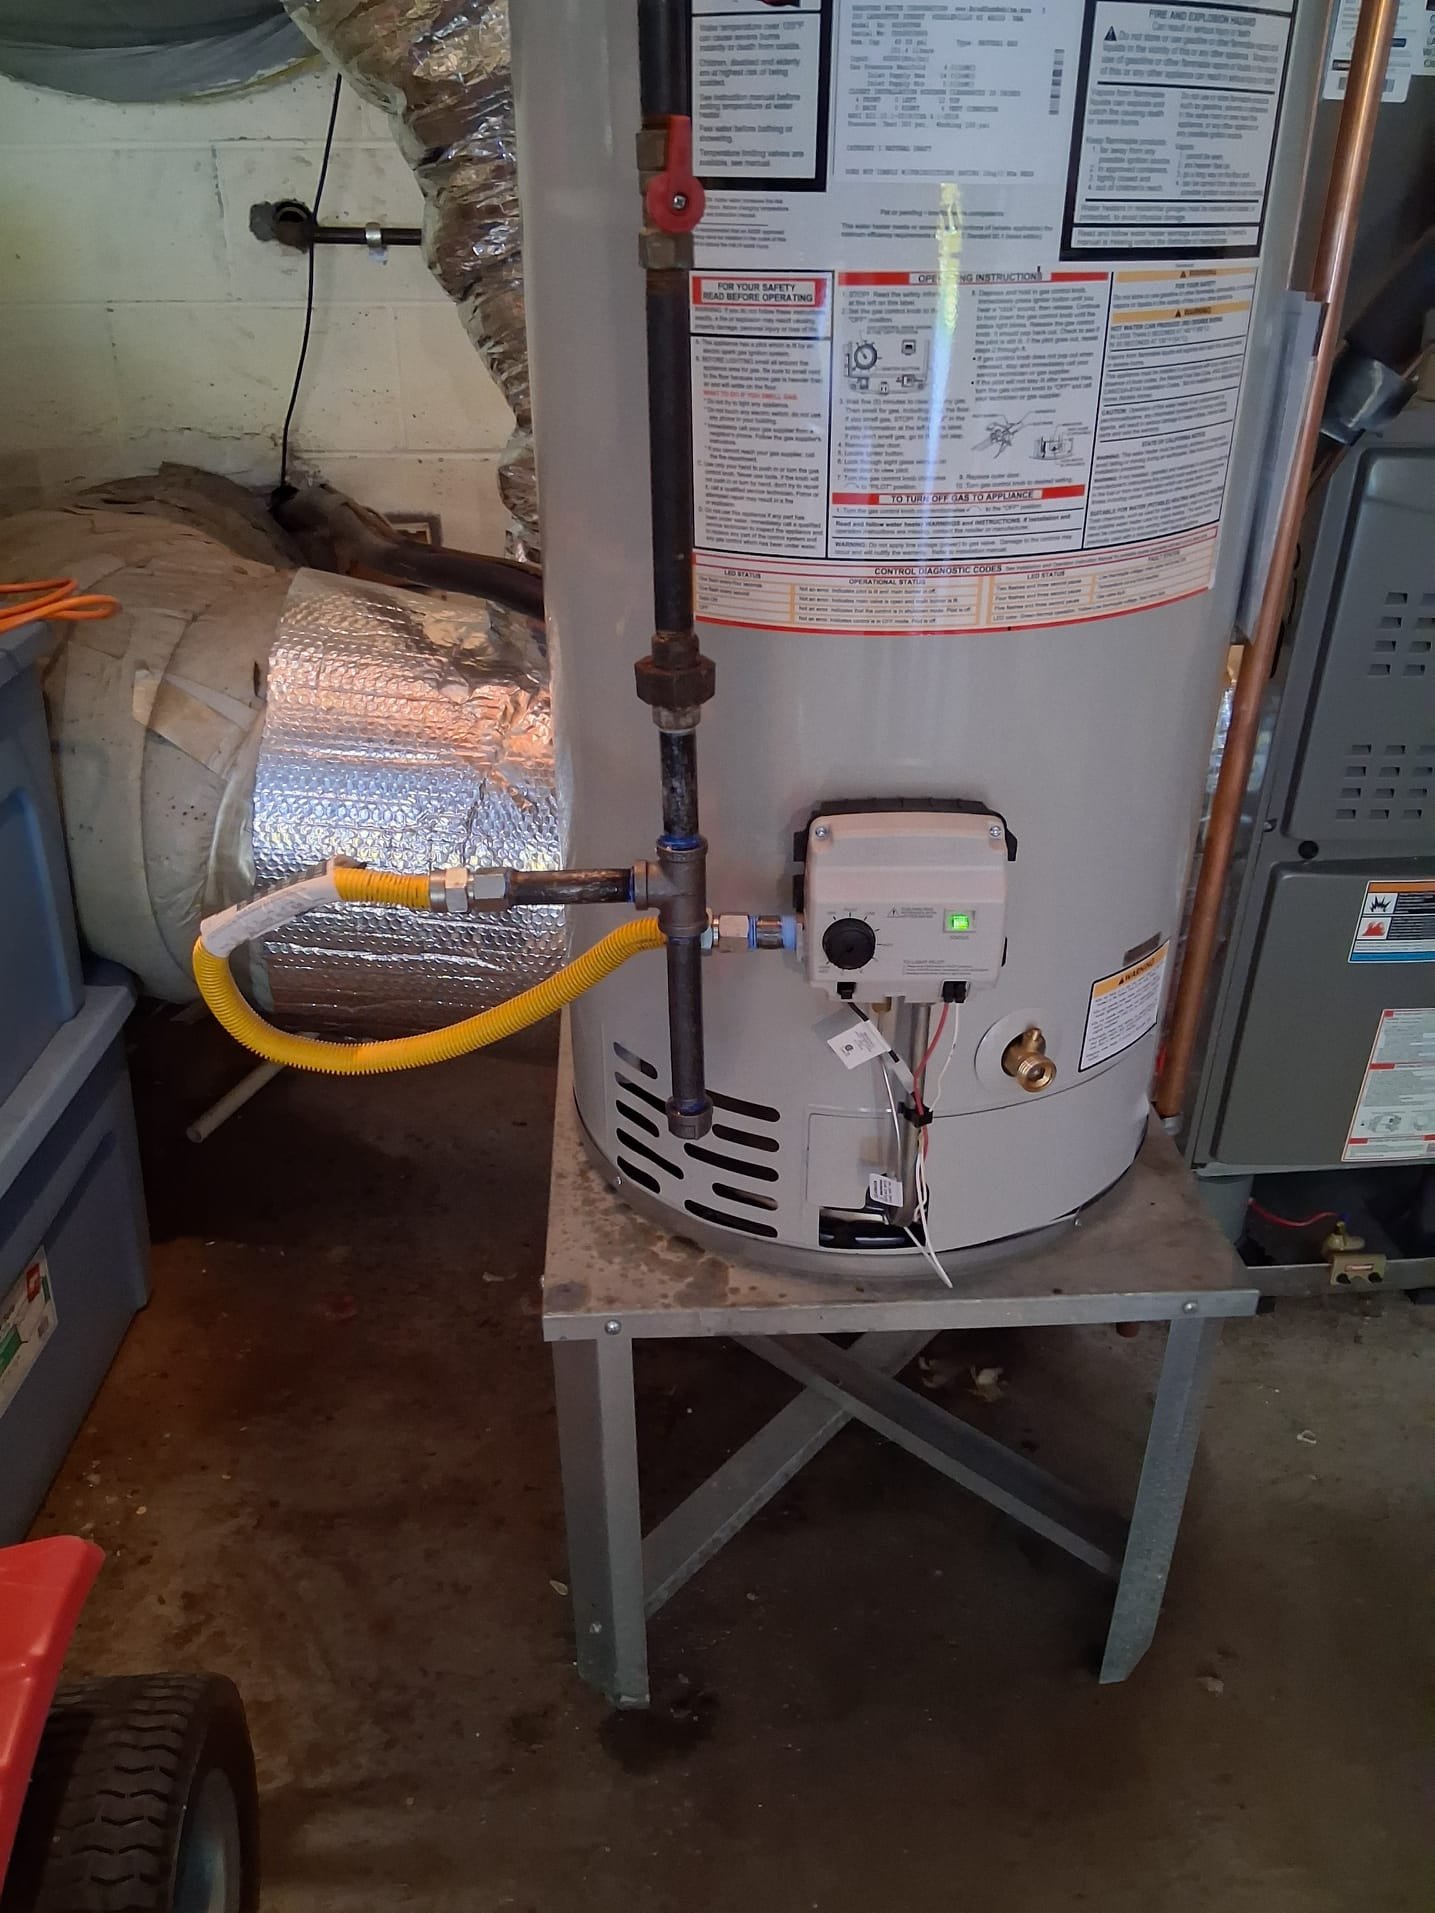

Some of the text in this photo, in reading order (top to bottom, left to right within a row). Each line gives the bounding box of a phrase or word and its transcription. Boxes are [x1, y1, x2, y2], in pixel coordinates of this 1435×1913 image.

[1150, 9, 1167, 19] FIRE
[1170, 11, 1187, 21] AND
[1189, 12, 1228, 24] EXPLOSION
[718, 283, 796, 292] FOR YOUR SAFETY
[703, 292, 813, 302] READ BEFORE OPERATING
[986, 492, 1032, 500] APPLIANCE
[919, 567, 970, 575] DIAGNOSTIC
